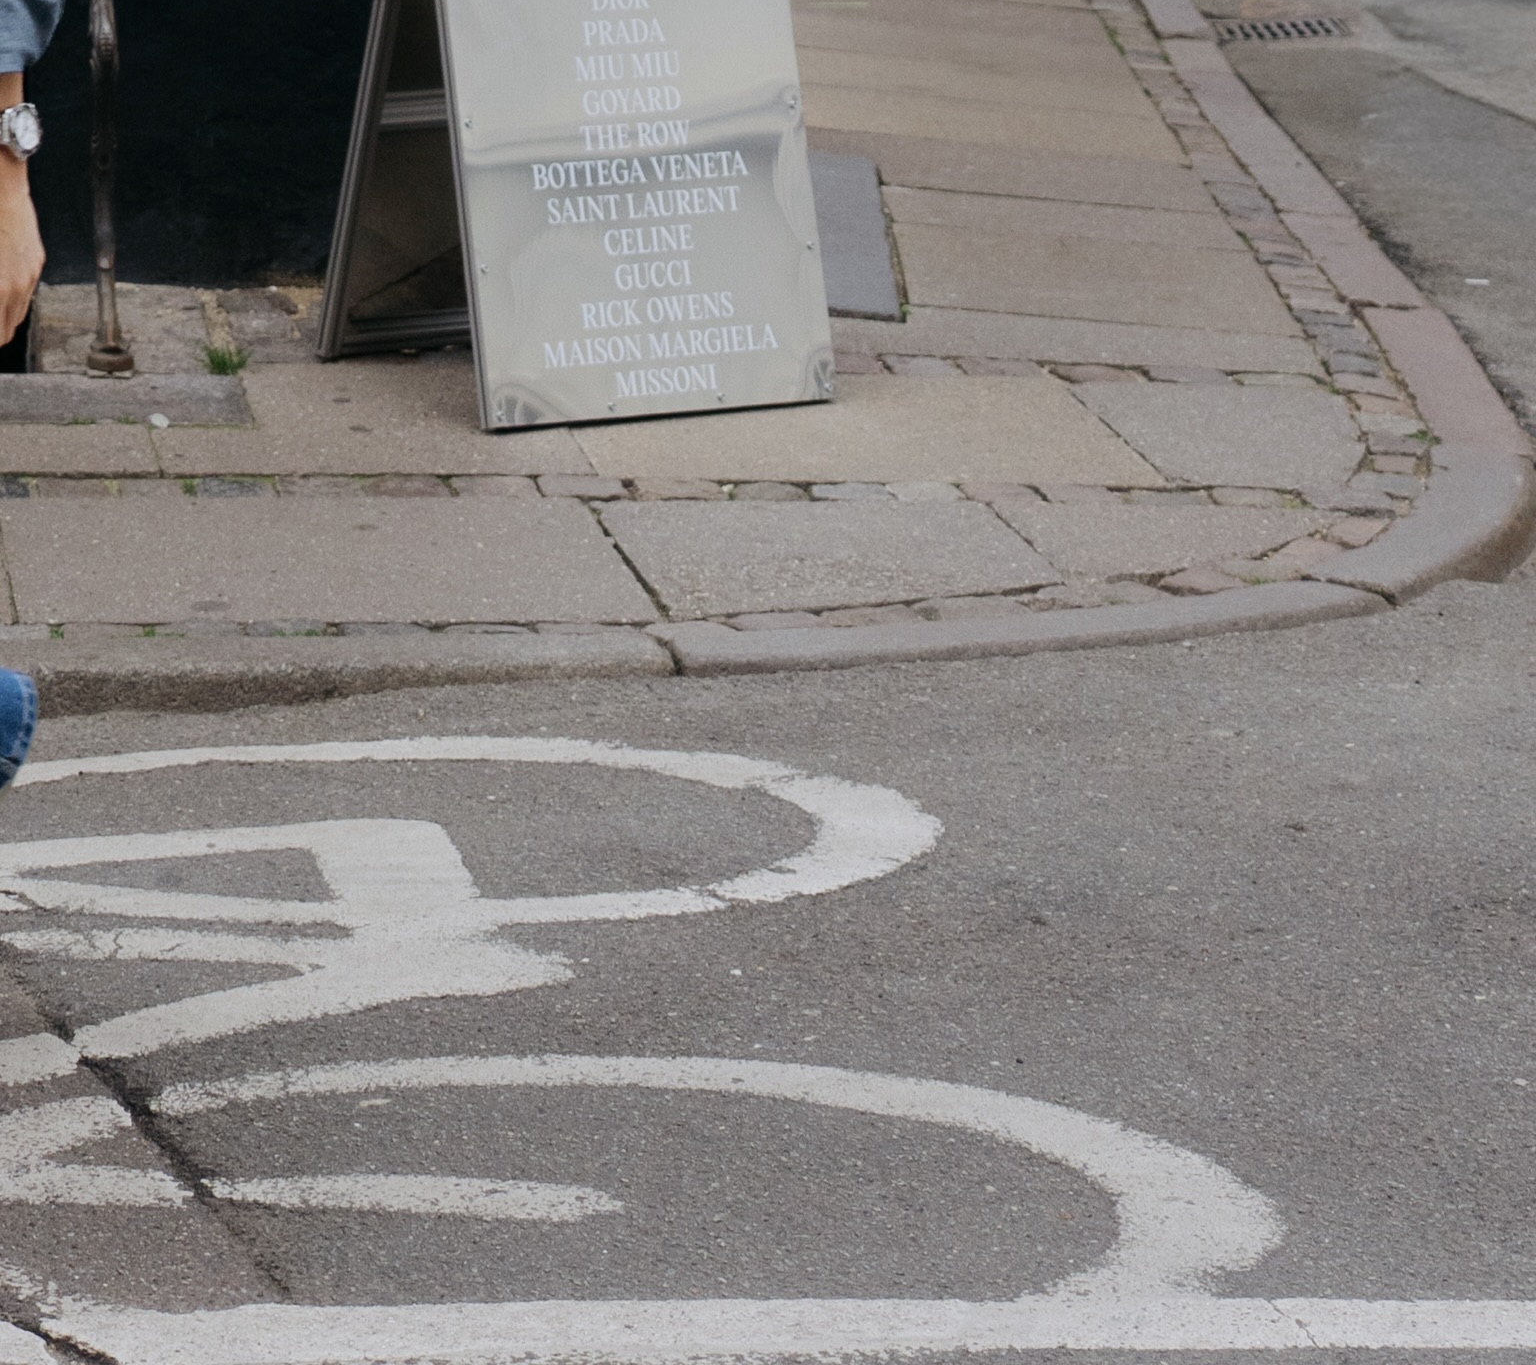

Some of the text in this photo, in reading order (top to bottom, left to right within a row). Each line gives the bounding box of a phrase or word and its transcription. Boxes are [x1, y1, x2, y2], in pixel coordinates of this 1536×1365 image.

[582, 18, 666, 46] PRADA
[575, 50, 681, 81] MIU MIU
[582, 85, 682, 116] GOYARD
[579, 120, 690, 151] THE ROW
[531, 149, 749, 191] BOTTEGA VENETA
[547, 185, 741, 225] SAINT LAURENT
[604, 224, 695, 256] CELINE
[614, 259, 693, 291] GUCCI
[580, 291, 735, 330] RICK OWENS
[543, 323, 780, 370] MAISON MARGIELA
[614, 363, 718, 398] MISSONI
